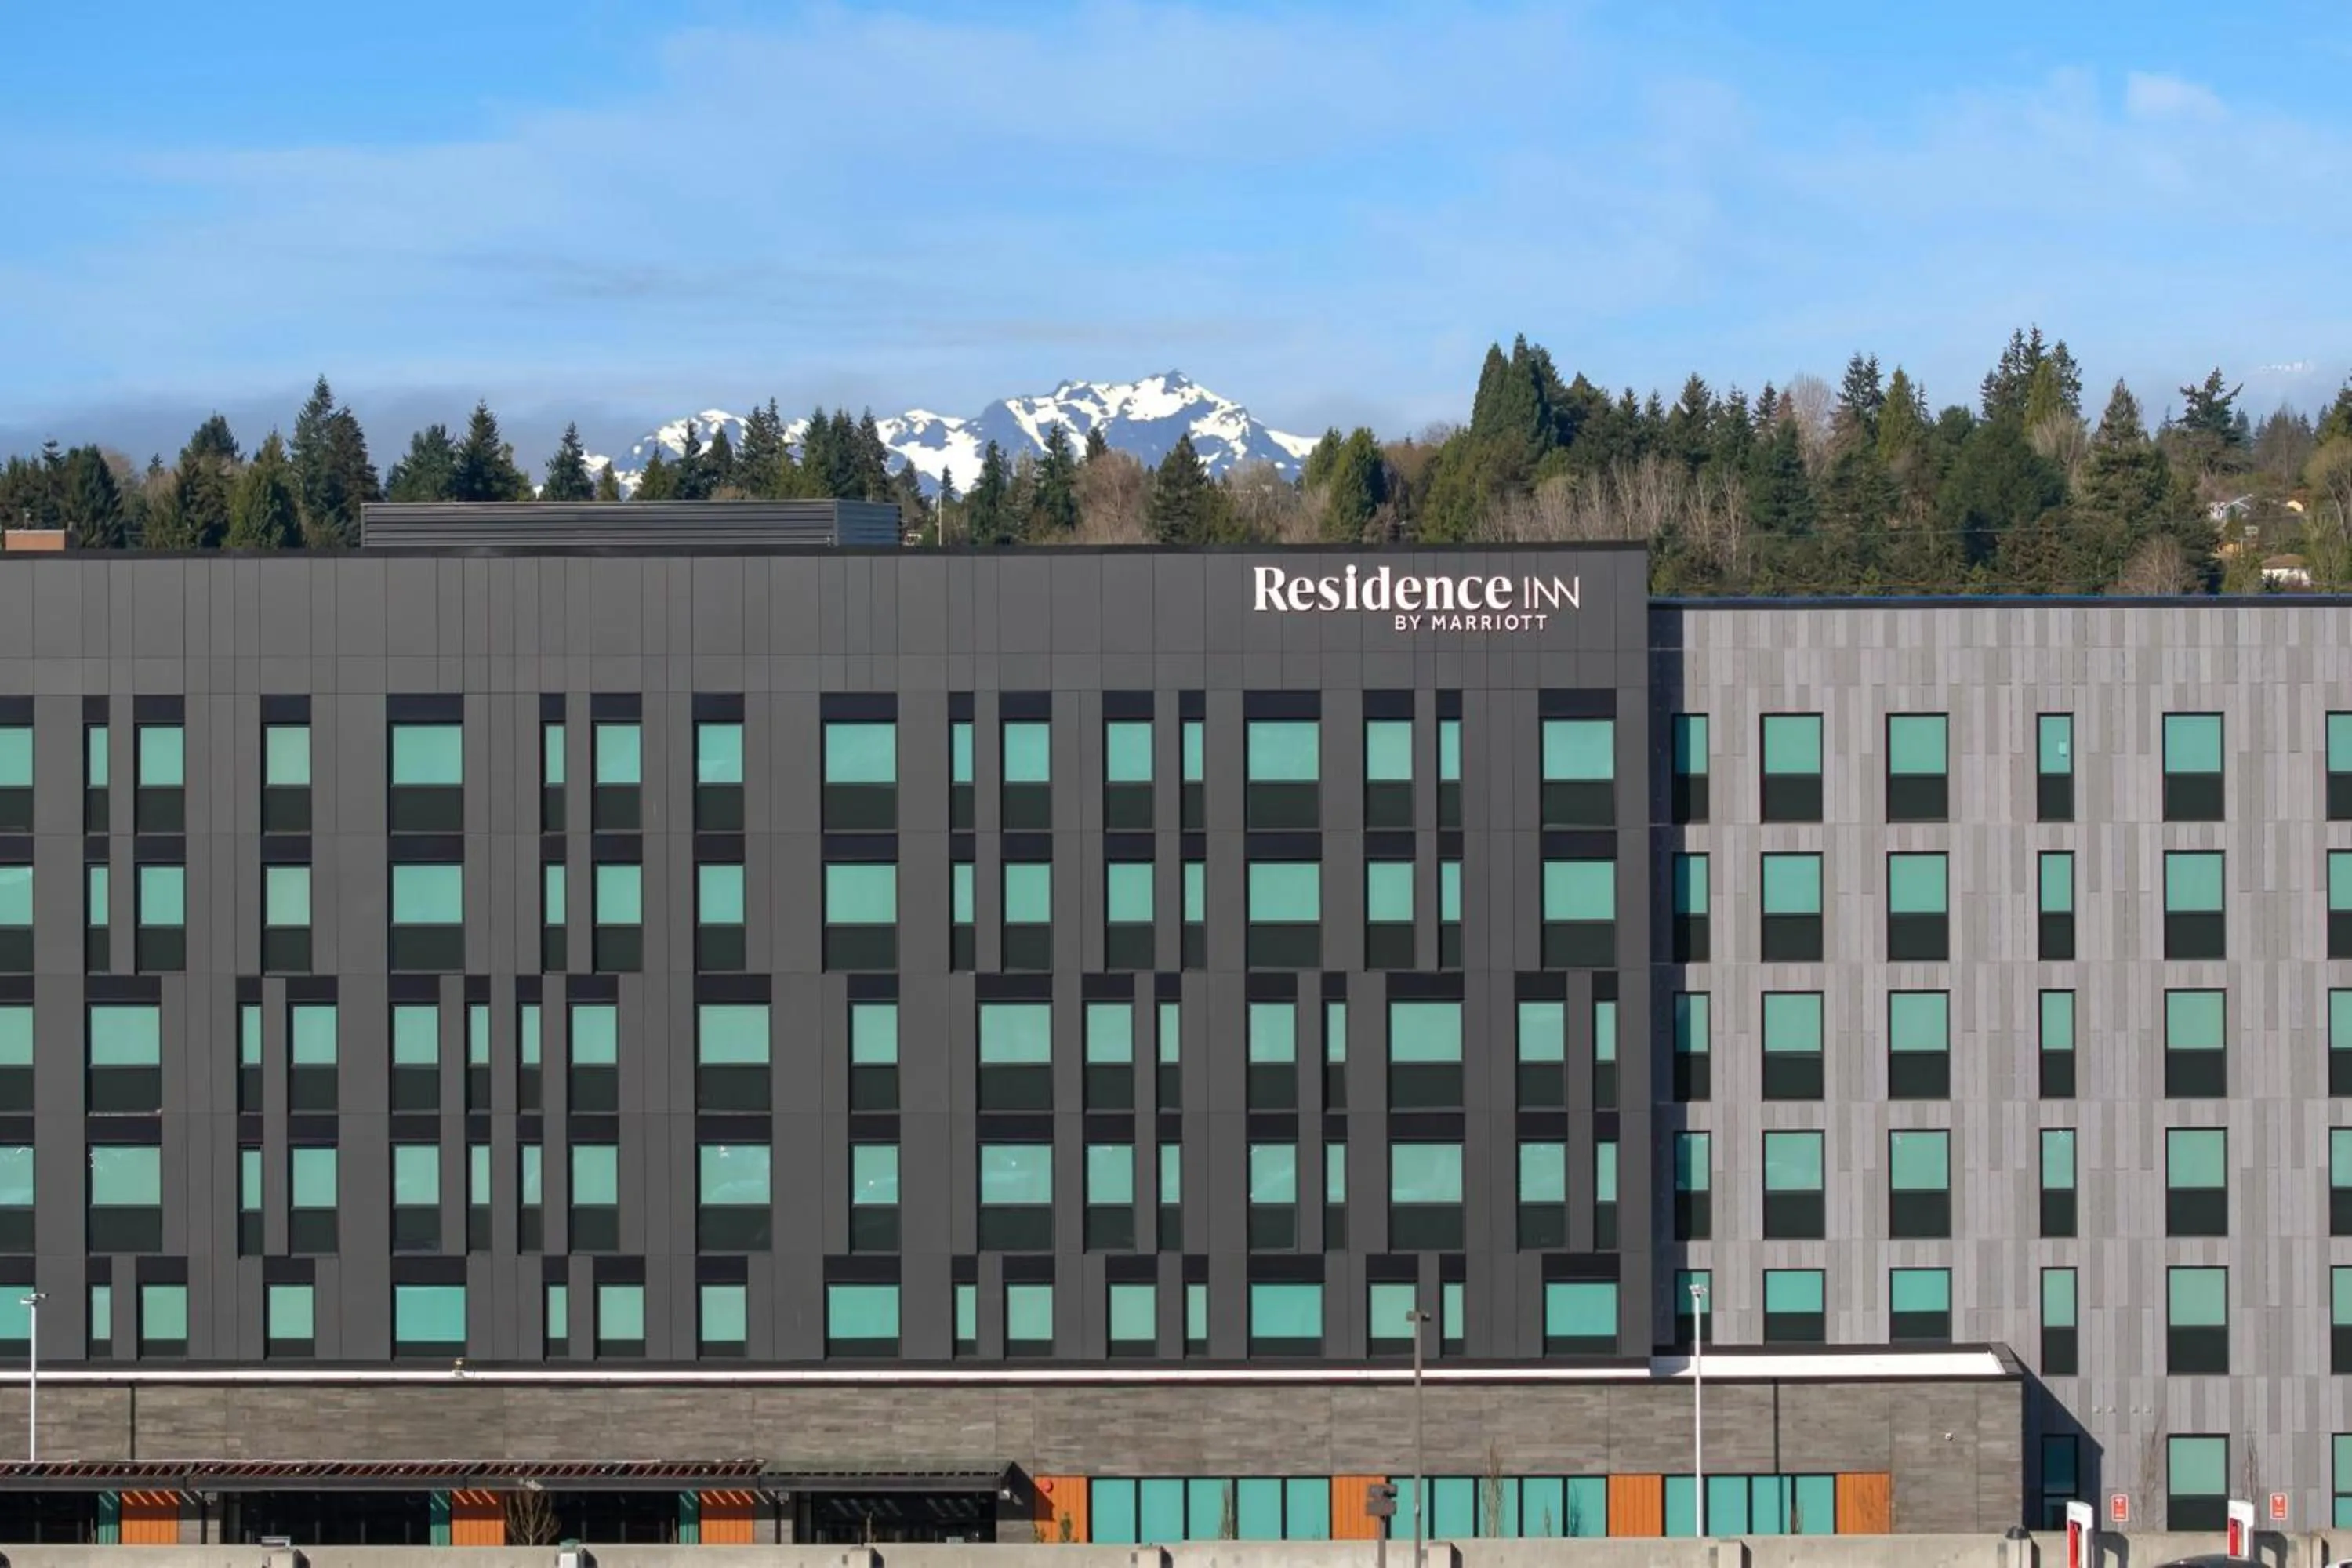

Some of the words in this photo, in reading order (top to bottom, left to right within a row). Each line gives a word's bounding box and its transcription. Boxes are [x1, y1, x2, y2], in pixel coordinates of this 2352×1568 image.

[1254, 564, 1512, 611] Residence
[1524, 576, 1580, 609] INN
[1395, 615, 1421, 630] BY
[1432, 615, 1548, 630] MARRIOTT
